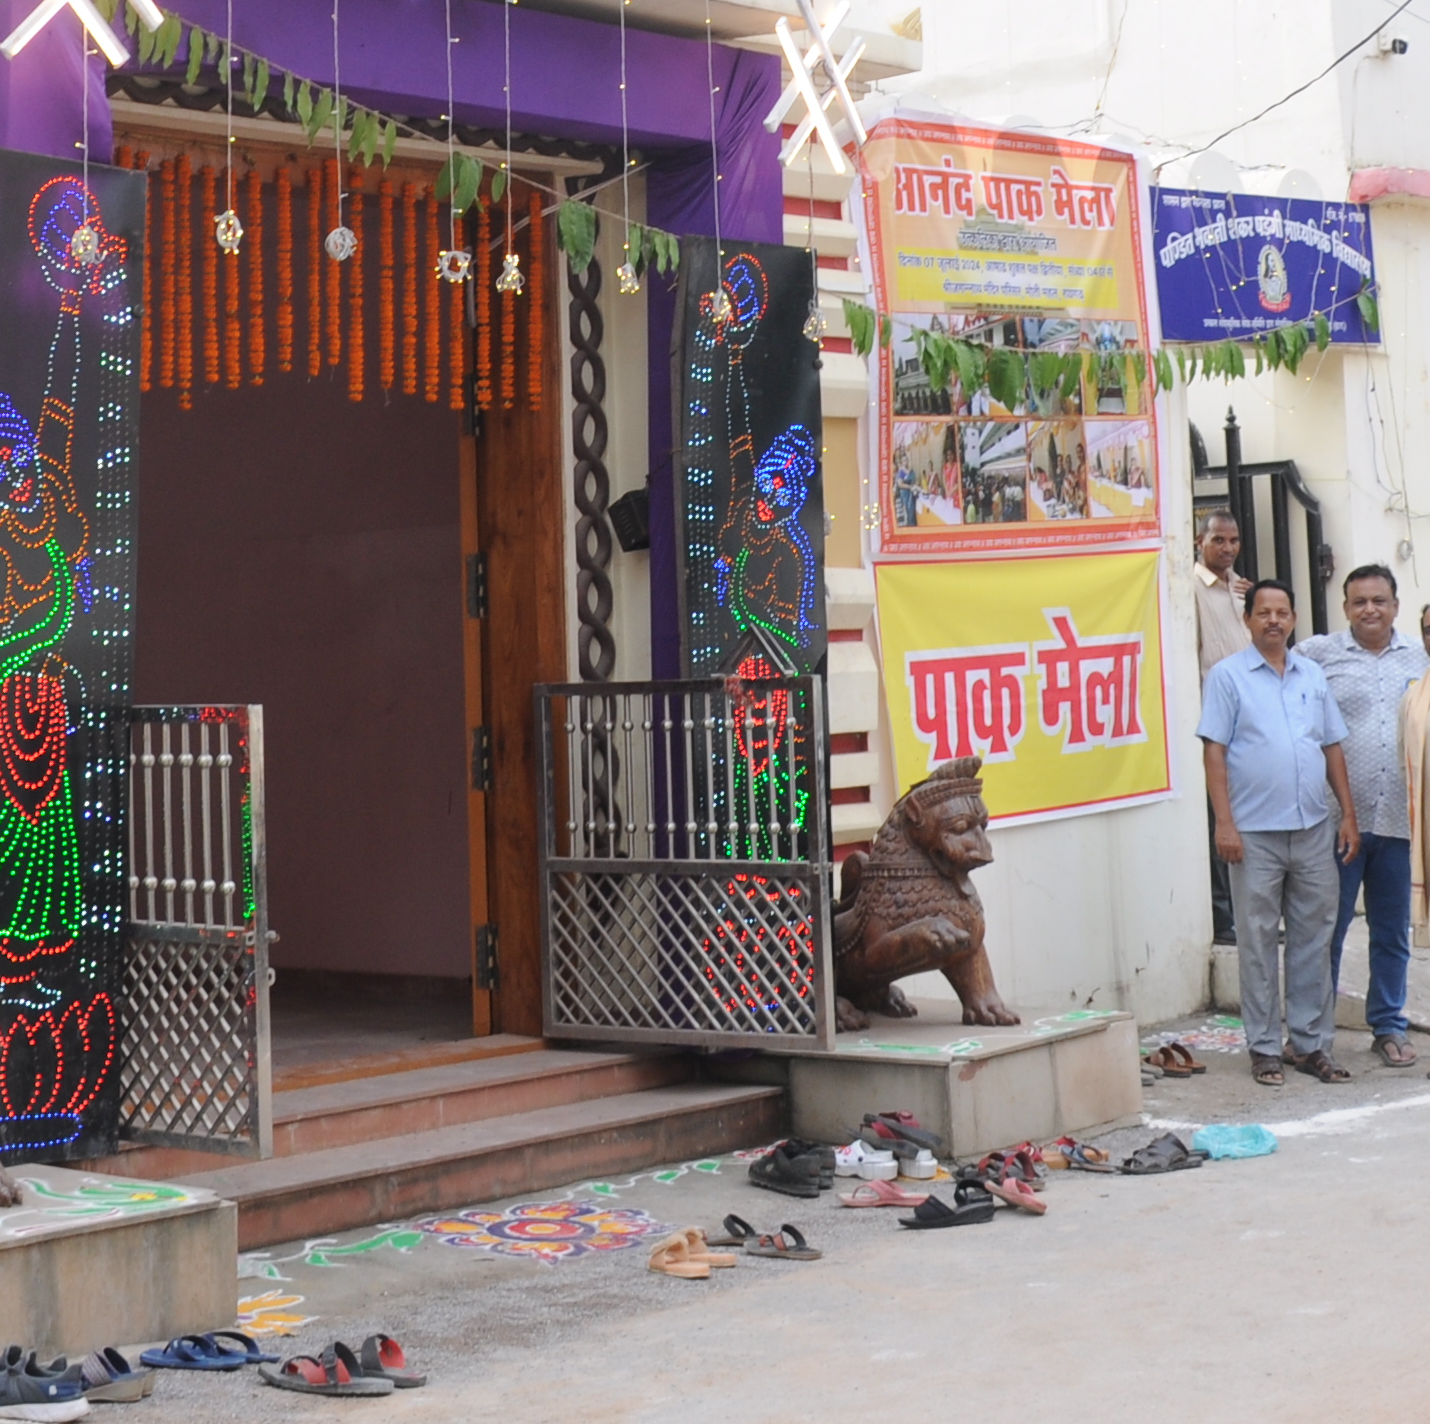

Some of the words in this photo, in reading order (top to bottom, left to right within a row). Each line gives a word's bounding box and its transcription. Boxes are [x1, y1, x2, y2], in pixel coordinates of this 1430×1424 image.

[893, 157, 974, 217] आनंद
[980, 175, 1044, 223] पाक
[1049, 168, 1116, 229] मेला
[908, 650, 1027, 761] पाक
[1036, 615, 1143, 745] मेला
